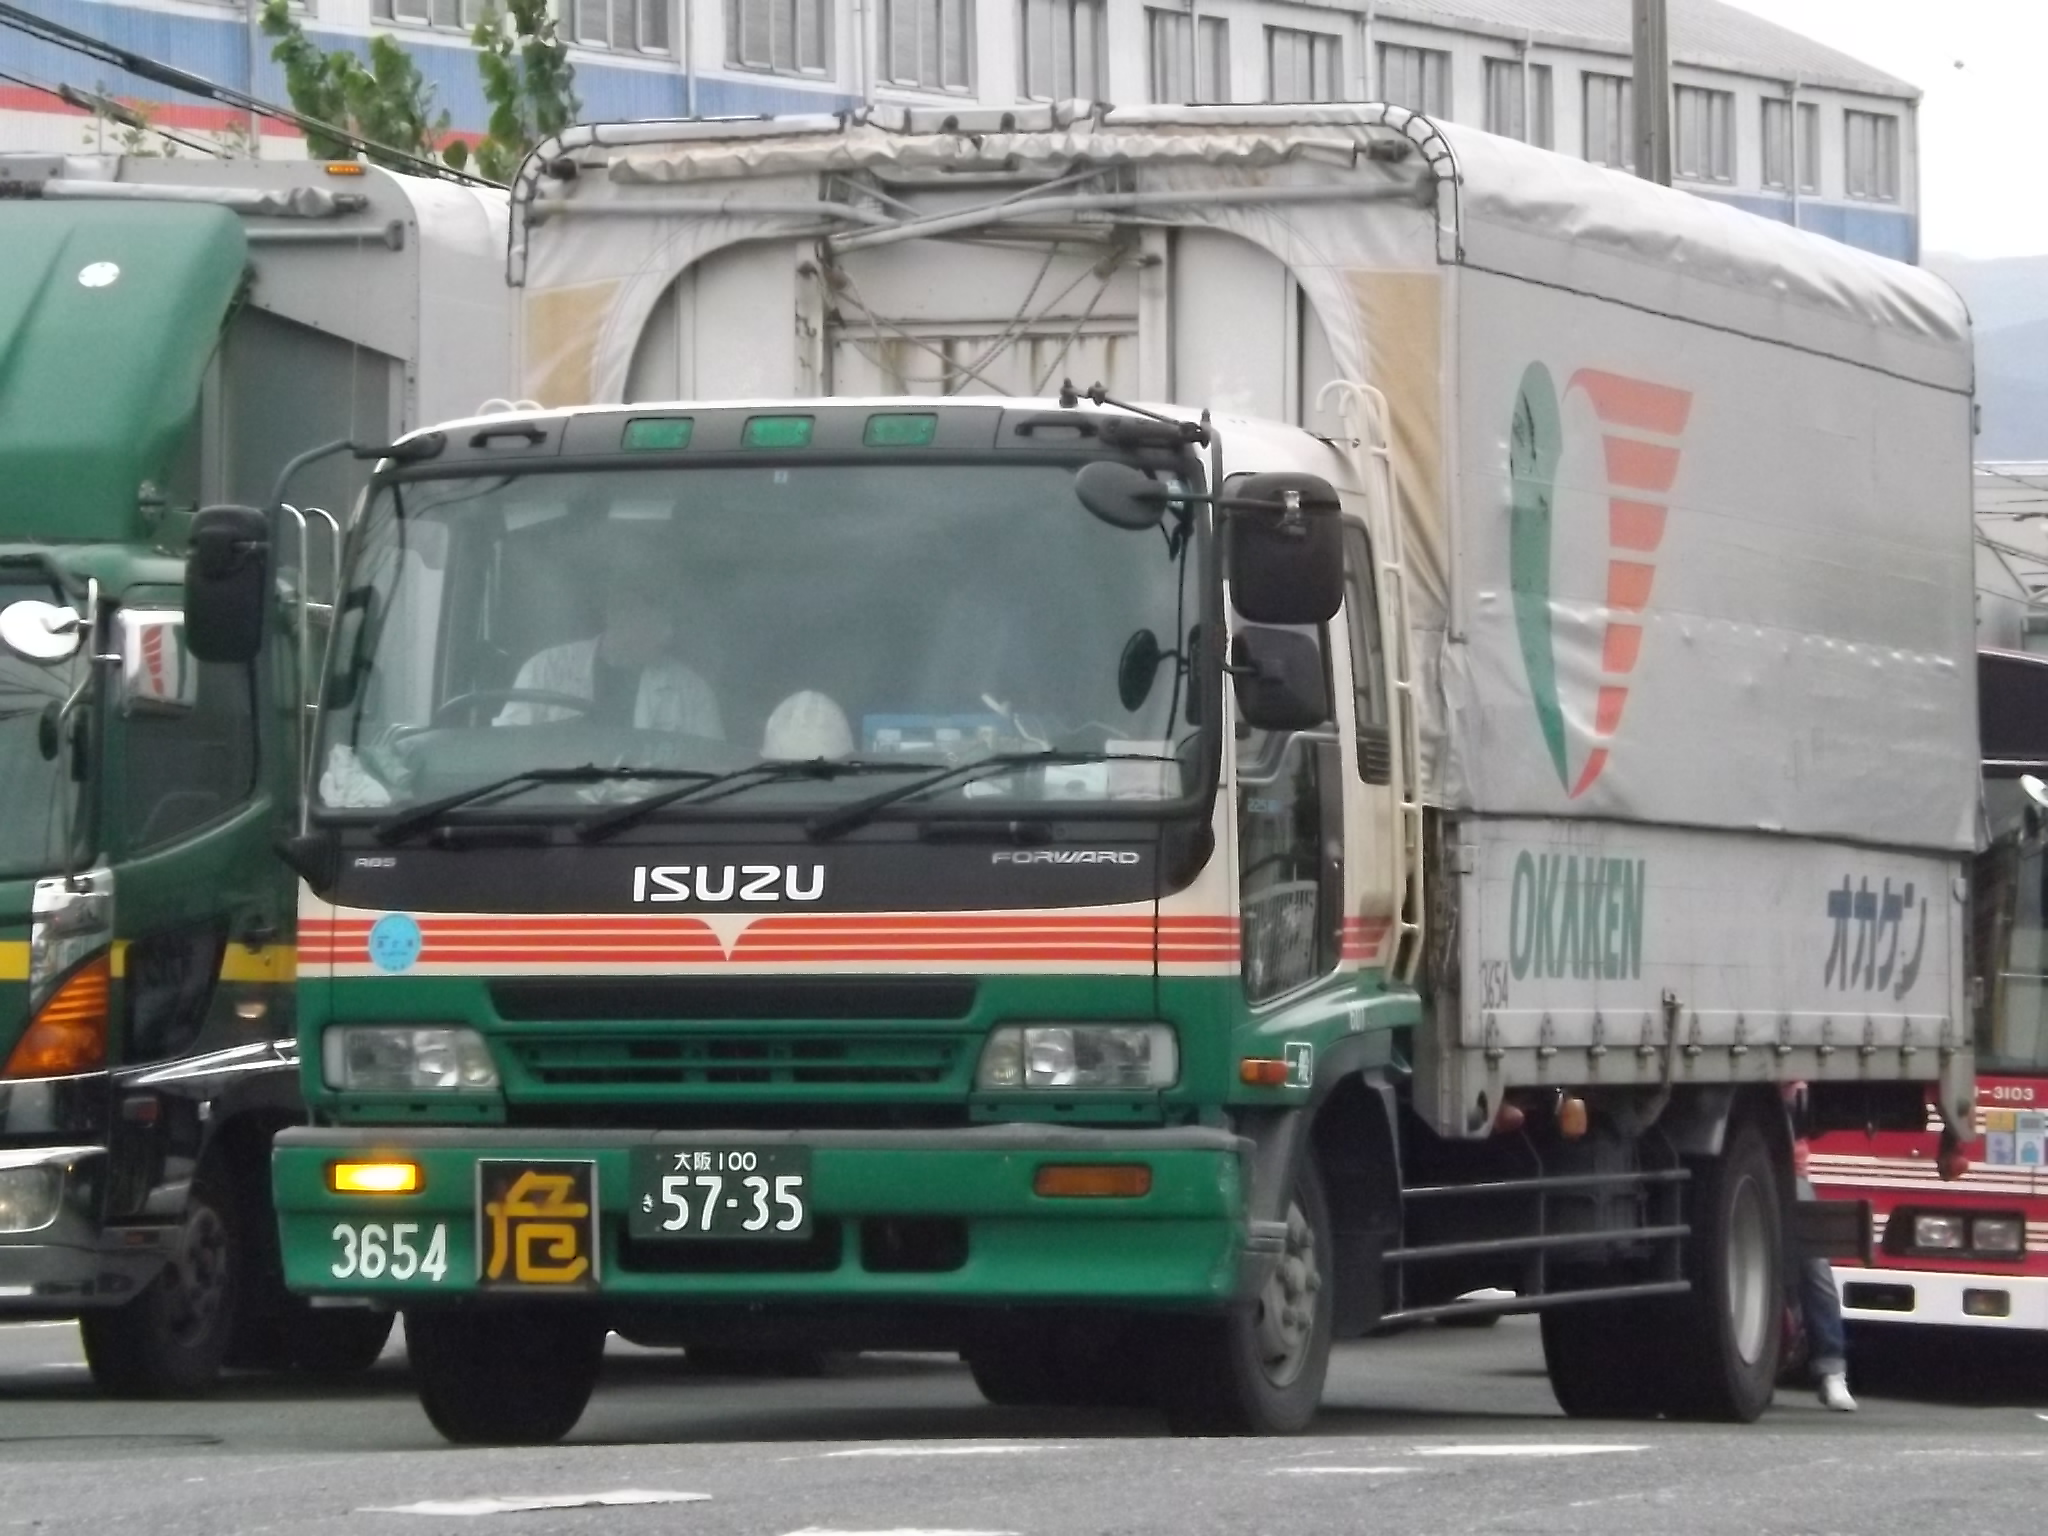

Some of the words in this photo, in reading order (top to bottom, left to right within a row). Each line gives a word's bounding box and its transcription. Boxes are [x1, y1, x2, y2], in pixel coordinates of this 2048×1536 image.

[632, 865, 826, 903] ISUZU
[991, 850, 1141, 865] FORWARD
[1509, 849, 1646, 982] OKAKEN
[1824, 873, 1928, 1001] オカケン
[1478, 960, 1509, 1009] 3654
[673, 1151, 712, 1171] 大阪
[718, 1151, 757, 1171] 100
[486, 1170, 589, 1284] 危
[661, 1175, 804, 1231] 57-35
[330, 1222, 449, 1283] 3654
